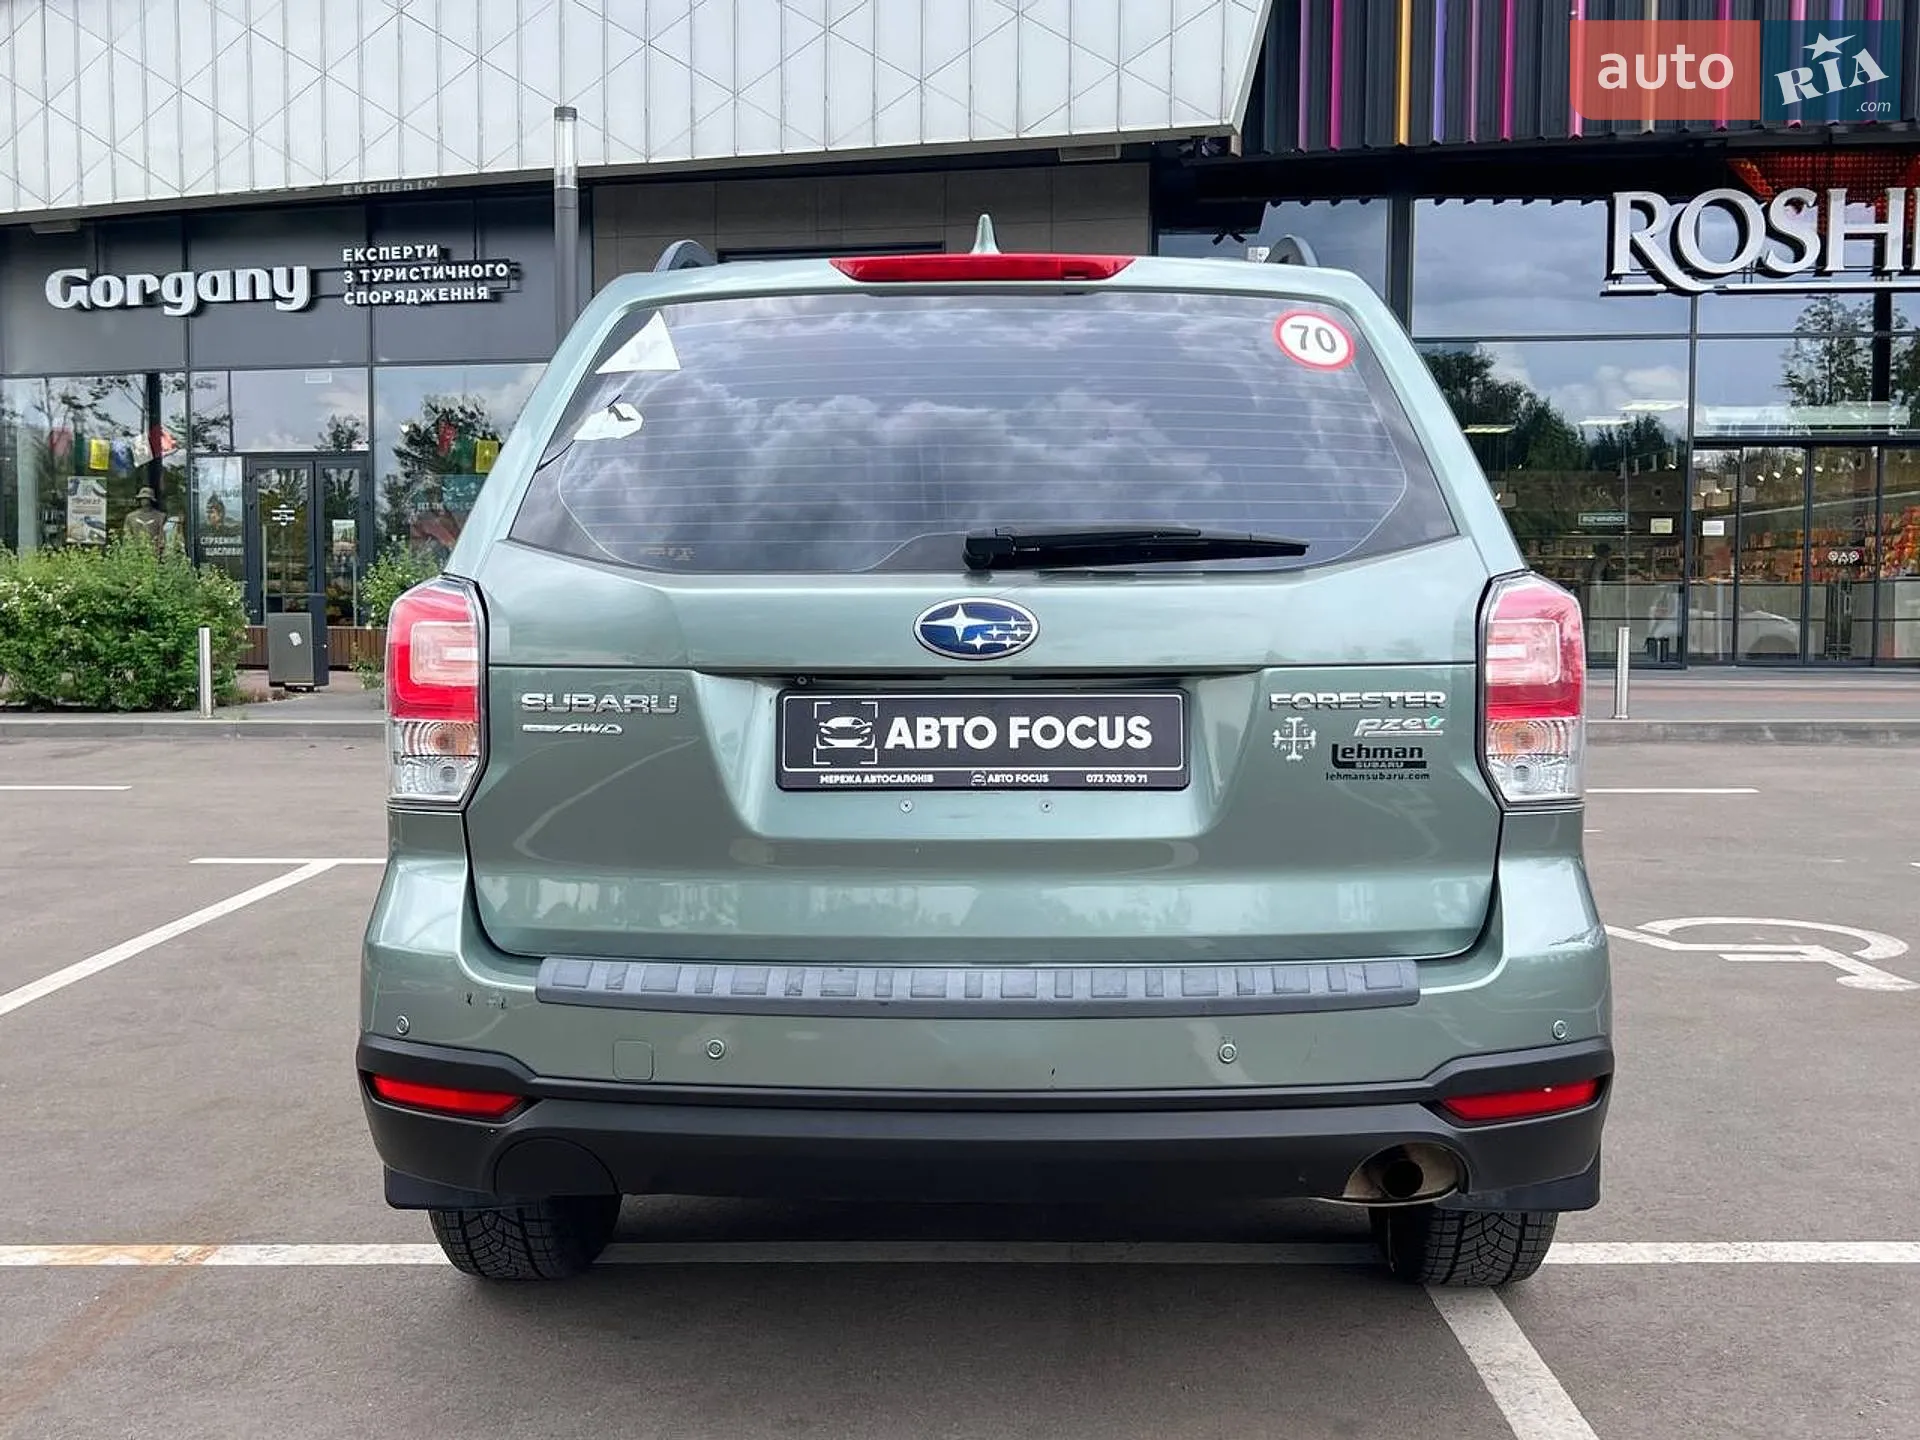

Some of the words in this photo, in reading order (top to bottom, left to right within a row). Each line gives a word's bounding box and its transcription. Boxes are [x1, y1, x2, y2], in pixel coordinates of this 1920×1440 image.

[1612, 187, 1920, 291] ROSH
[342, 244, 439, 262] ЕКСПЕРТИ
[360, 263, 509, 283] ТУРИСТИЧНОГО
[45, 265, 311, 317] Gorgany
[344, 287, 489, 306] СПОРЯДЖЕННЯ
[1290, 324, 1337, 354] 70
[521, 693, 678, 713] SUBARU
[1269, 691, 1447, 711] FORESTER
[883, 715, 998, 750] АВТО
[1008, 715, 1153, 750] FOCUS
[1331, 743, 1425, 764] Lehman
[820, 774, 862, 784] МЕРЕЖА
[863, 774, 934, 784] АВТОСАЛОНІВ
[987, 774, 1014, 784] АВТО
[1016, 774, 1050, 784] FOCUS
[1086, 774, 1103, 783] 073
[1105, 774, 1122, 783] 703
[1124, 774, 1136, 783] 70
[1138, 774, 1148, 783] 71
[1326, 772, 1430, 781] lehmansubaru.com
